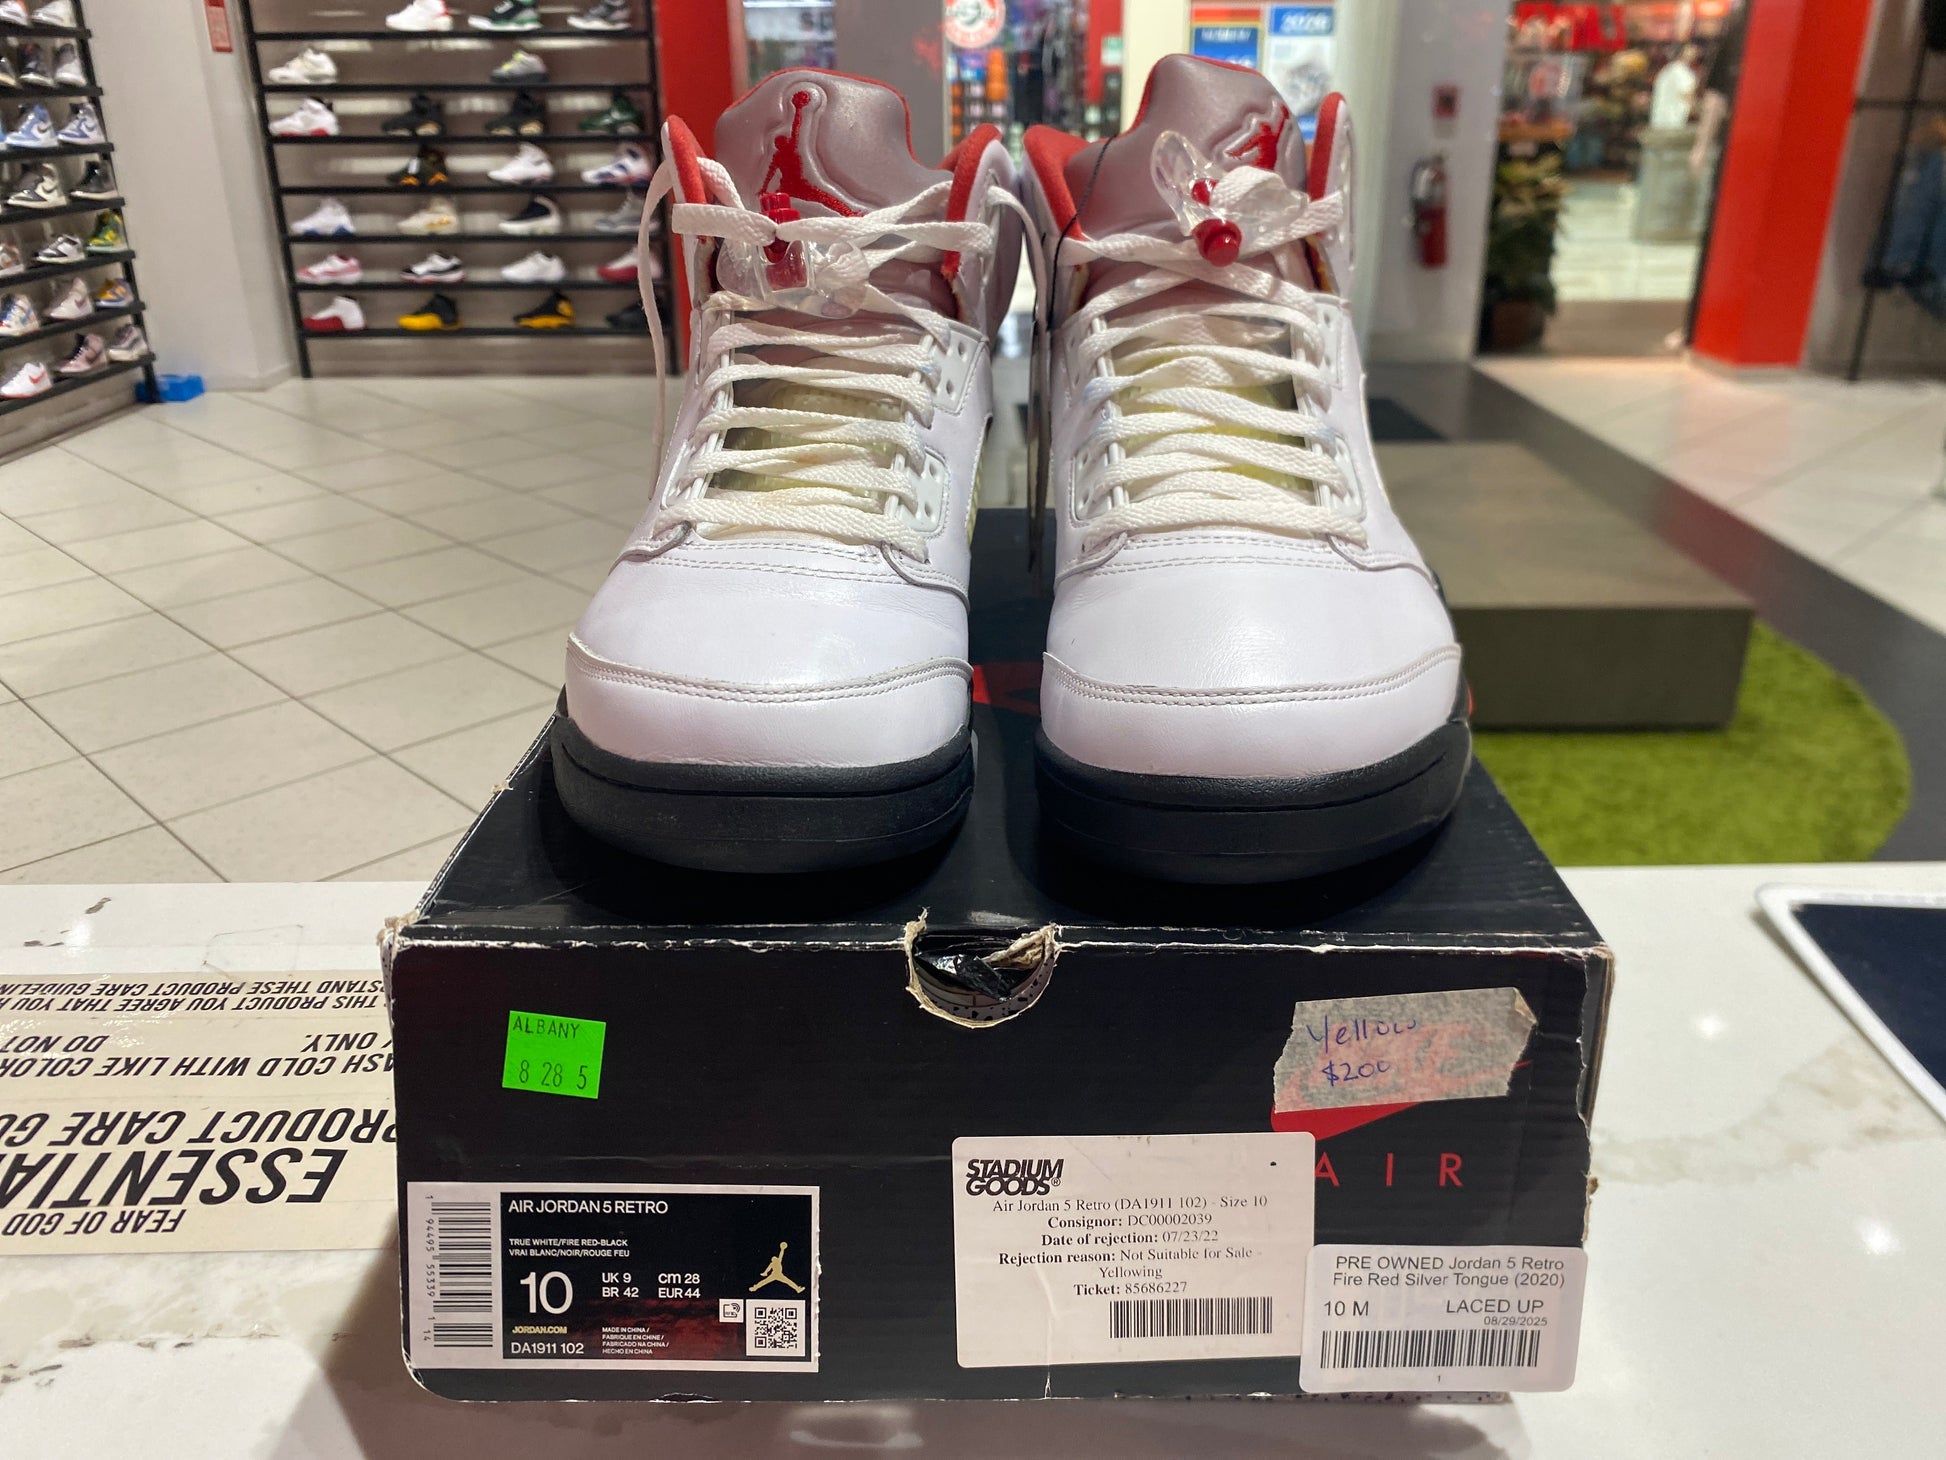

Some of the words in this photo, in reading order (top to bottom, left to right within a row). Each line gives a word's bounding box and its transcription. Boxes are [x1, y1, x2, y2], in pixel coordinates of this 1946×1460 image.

[91, 983, 149, 996] CARE
[148, 982, 246, 997] PRODUCT
[247, 981, 311, 995] THESE
[10, 997, 55, 1011] YOU
[56, 998, 113, 1012] THAT
[113, 997, 186, 1012] AGREE
[185, 997, 229, 1011] YOU
[231, 995, 330, 1011] PRODUCT
[332, 995, 379, 1009] THIS
[513, 1015, 580, 1039] ALBANY
[1306, 1015, 1418, 1053] Yellow
[0, 1035, 62, 1053] NOT
[63, 1035, 109, 1053] DO
[300, 1032, 378, 1053] ONLY.
[93, 1057, 170, 1077] LIKE
[169, 1057, 251, 1077] WITH
[256, 1057, 337, 1077] COLD
[1321, 1060, 1392, 1087] $200
[519, 1060, 530, 1084] 8
[541, 1061, 563, 1088] 28
[576, 1064, 589, 1091] 5
[47, 1111, 186, 1147] CARE
[966, 1158, 1065, 1179] STADIUM
[1314, 1151, 1464, 1187] AIR
[0, 1148, 348, 1209] ESSENTIA
[508, 1199, 534, 1213] AIR
[535, 1199, 600, 1214] JORDAN
[602, 1200, 613, 1214] 5
[614, 1200, 669, 1214] RETRO
[993, 1200, 1014, 1212] Air
[1018, 1199, 1060, 1212] Jordan
[1064, 1199, 1071, 1212] 5
[1076, 1199, 1111, 1212] Retro
[1114, 1197, 1172, 1212] (DA1911
[1179, 1196, 1207, 1210] 102)
[1219, 1195, 1248, 1208] Size
[1253, 1195, 1268, 1207] 10
[1, 1212, 65, 1236] GOD
[63, 1211, 108, 1235] OF
[110, 1209, 187, 1233] FEAR
[1047, 1215, 1123, 1230] Consignor:
[1128, 1213, 1213, 1227] DC00002039
[509, 1238, 531, 1246] TRUE
[532, 1238, 580, 1247] WHITE/FIRE
[581, 1238, 628, 1247] RED-BLACK
[1041, 1234, 1073, 1246] Date
[1077, 1233, 1091, 1245] of
[1094, 1232, 1158, 1247] rejection:
[1162, 1230, 1219, 1243] 07/23/22
[509, 1249, 528, 1257] VRAI
[529, 1249, 612, 1258] BLANC/NOIR/ROUGE
[614, 1249, 630, 1257] FEU
[999, 1251, 1062, 1267] Rejection
[1067, 1253, 1116, 1263] reason:
[1120, 1249, 1143, 1262] Not
[1147, 1247, 1199, 1261] Suitable
[1204, 1247, 1222, 1259] for
[1225, 1246, 1253, 1259] Sale
[1336, 1256, 1372, 1269] PRE
[1377, 1256, 1444, 1270] OWNED
[1448, 1256, 1501, 1270] Jordan
[1506, 1256, 1516, 1269] 5
[1521, 1256, 1565, 1270] Retro
[426, 1264, 436, 1297] 55339
[601, 1272, 619, 1284] UK
[622, 1272, 632, 1284] 9
[684, 1273, 700, 1284] 28
[1099, 1265, 1163, 1280] Yellowing
[1333, 1272, 1363, 1286] Fire
[1367, 1272, 1400, 1286] Red
[1404, 1272, 1449, 1286] Silver
[1453, 1272, 1509, 1288] Tongue
[1514, 1272, 1565, 1289] (2020)
[519, 1271, 573, 1314] 10
[601, 1287, 619, 1298] BR
[623, 1287, 640, 1298] 42
[658, 1287, 683, 1298] EUR
[684, 1287, 701, 1299] 44
[1073, 1283, 1120, 1296] Ticket:
[1125, 1281, 1188, 1295] 85686227
[1323, 1300, 1346, 1316] 10
[1352, 1300, 1369, 1316] M
[1446, 1299, 1511, 1314] LACED
[1517, 1299, 1545, 1313] UP
[1483, 1315, 1548, 1326] 08/29/2025
[512, 1326, 568, 1334] JORDAN.COM
[511, 1342, 557, 1354] DA1911
[560, 1342, 584, 1354] 102
